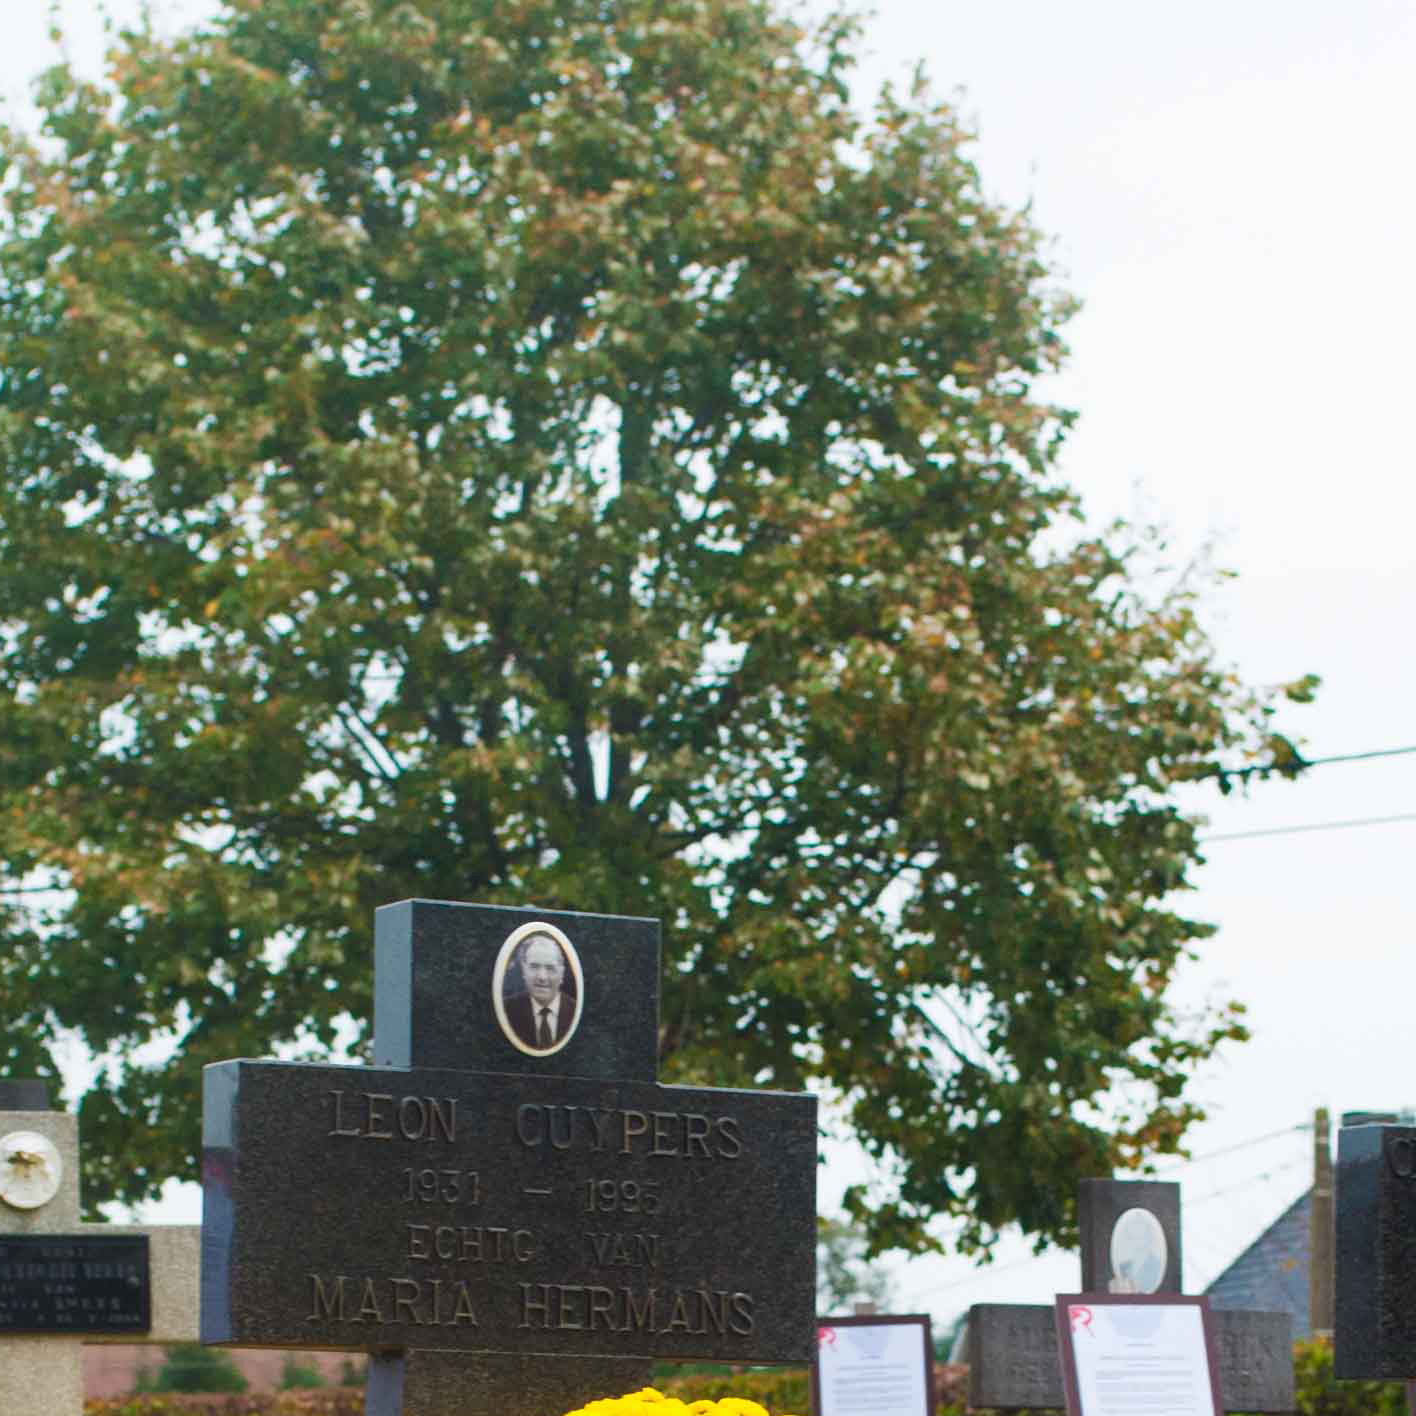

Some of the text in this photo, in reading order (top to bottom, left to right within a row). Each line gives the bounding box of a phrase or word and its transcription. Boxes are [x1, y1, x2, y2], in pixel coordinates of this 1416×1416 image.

[327, 1089, 744, 1162] LEON CUYPERS
[401, 1167, 481, 1208] 1931
[406, 1222, 663, 1271] ECHTG VAN
[304, 1271, 756, 1337] MARIA HERMANS
